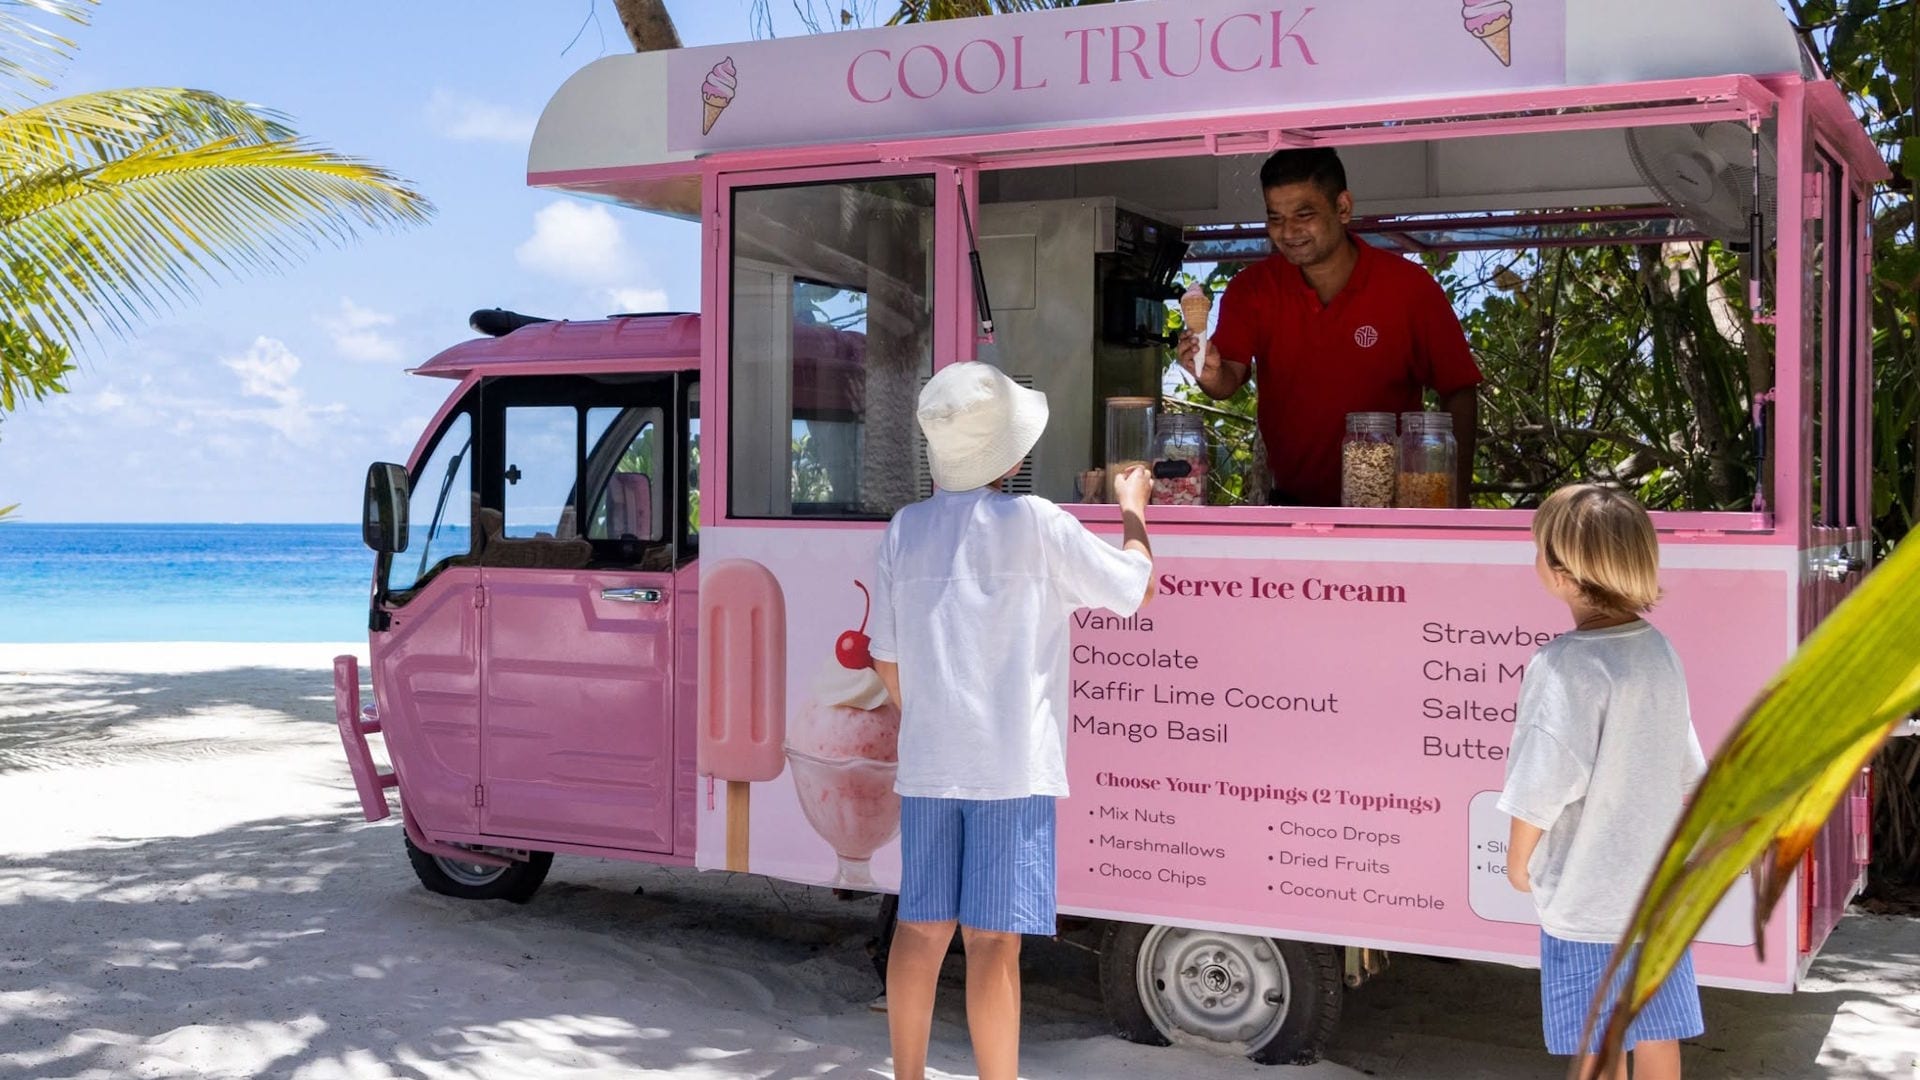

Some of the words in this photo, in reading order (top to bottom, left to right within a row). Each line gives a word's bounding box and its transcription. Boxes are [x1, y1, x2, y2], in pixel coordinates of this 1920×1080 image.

[847, 35, 1047, 103] COOL
[1064, 7, 1319, 84] TRUCK
[1159, 573, 1242, 597] Serve
[1250, 576, 1295, 599] Ice
[1302, 577, 1406, 603] Cream
[1073, 611, 1153, 632] Vanilla
[1073, 645, 1199, 670] Chocolate
[1422, 660, 1486, 682] Chai
[1073, 680, 1144, 702] Kaffir
[1154, 683, 1215, 707] Lime
[1225, 687, 1339, 714] Coconut
[1423, 698, 1517, 722] Salted
[1073, 715, 1158, 743] Mango
[1168, 720, 1228, 744] Basil
[1095, 771, 1161, 792] Choose
[1166, 777, 1211, 795] Your
[1216, 780, 1308, 805] Toppings
[1312, 788, 1331, 805] (2
[1335, 790, 1442, 814] Toppings)
[1099, 806, 1129, 821] Mix
[1134, 808, 1176, 825] Nuts
[1280, 821, 1338, 840] Choco
[1343, 826, 1401, 846] Drops
[1099, 835, 1226, 859] Marshmallows
[1099, 863, 1152, 881] Choco
[1157, 868, 1207, 887] Chips
[1280, 851, 1329, 868] Dried
[1336, 856, 1391, 875] Fruits
[1280, 880, 1357, 902] Coconut
[1362, 888, 1445, 911] Crumble
